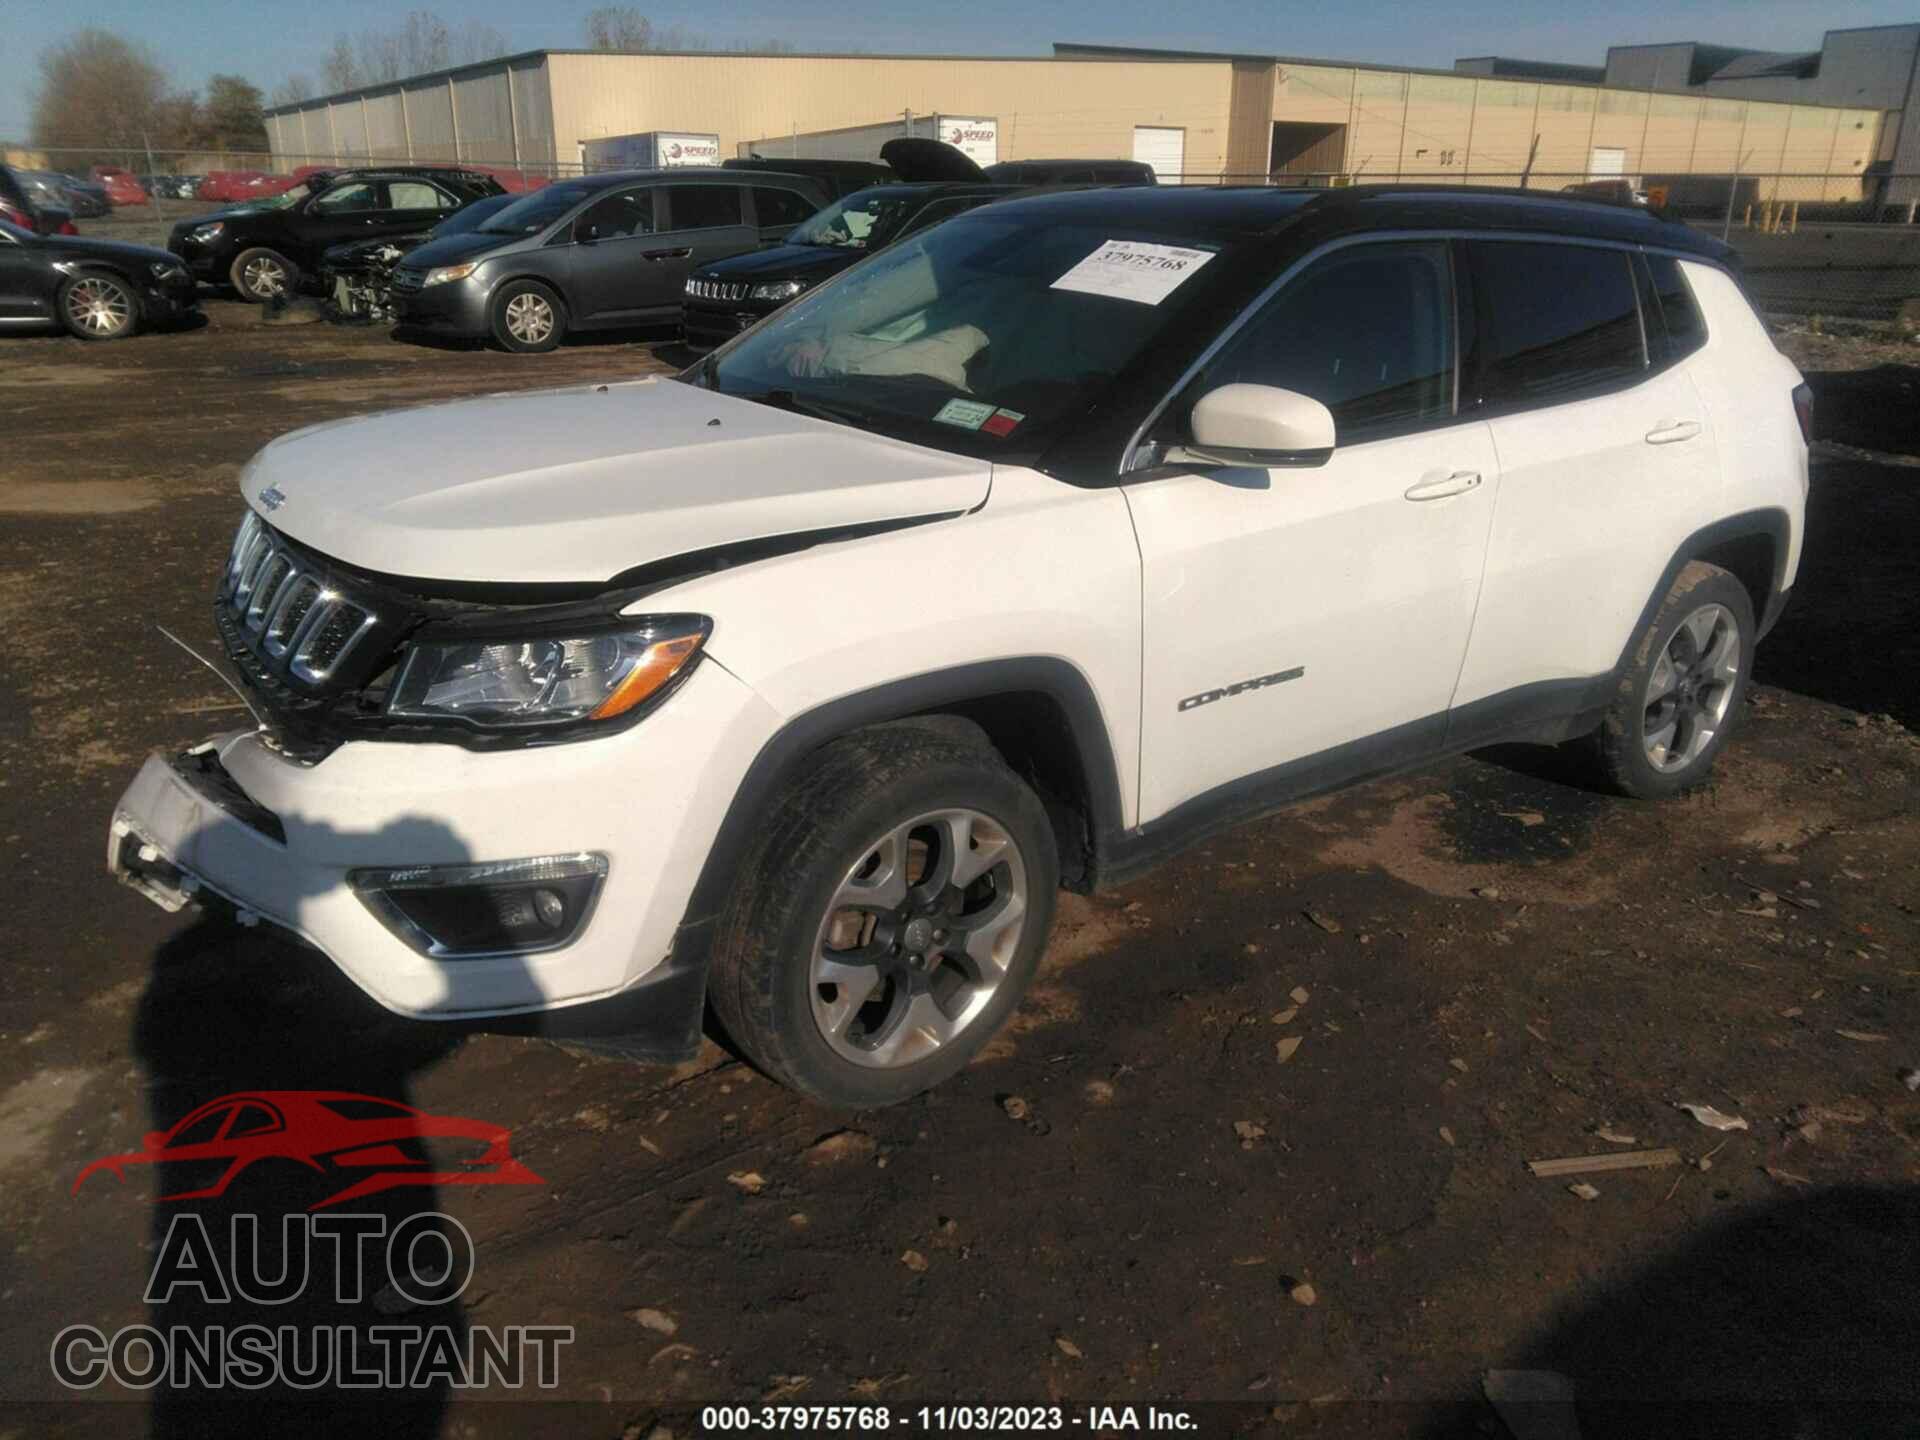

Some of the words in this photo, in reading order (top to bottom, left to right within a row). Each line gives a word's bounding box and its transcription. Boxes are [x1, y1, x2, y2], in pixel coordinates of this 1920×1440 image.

[963, 130, 994, 138] SPEED
[684, 146, 717, 155] SPEED
[1099, 251, 1188, 272] 37975768
[1178, 666, 1305, 712] COMPASS
